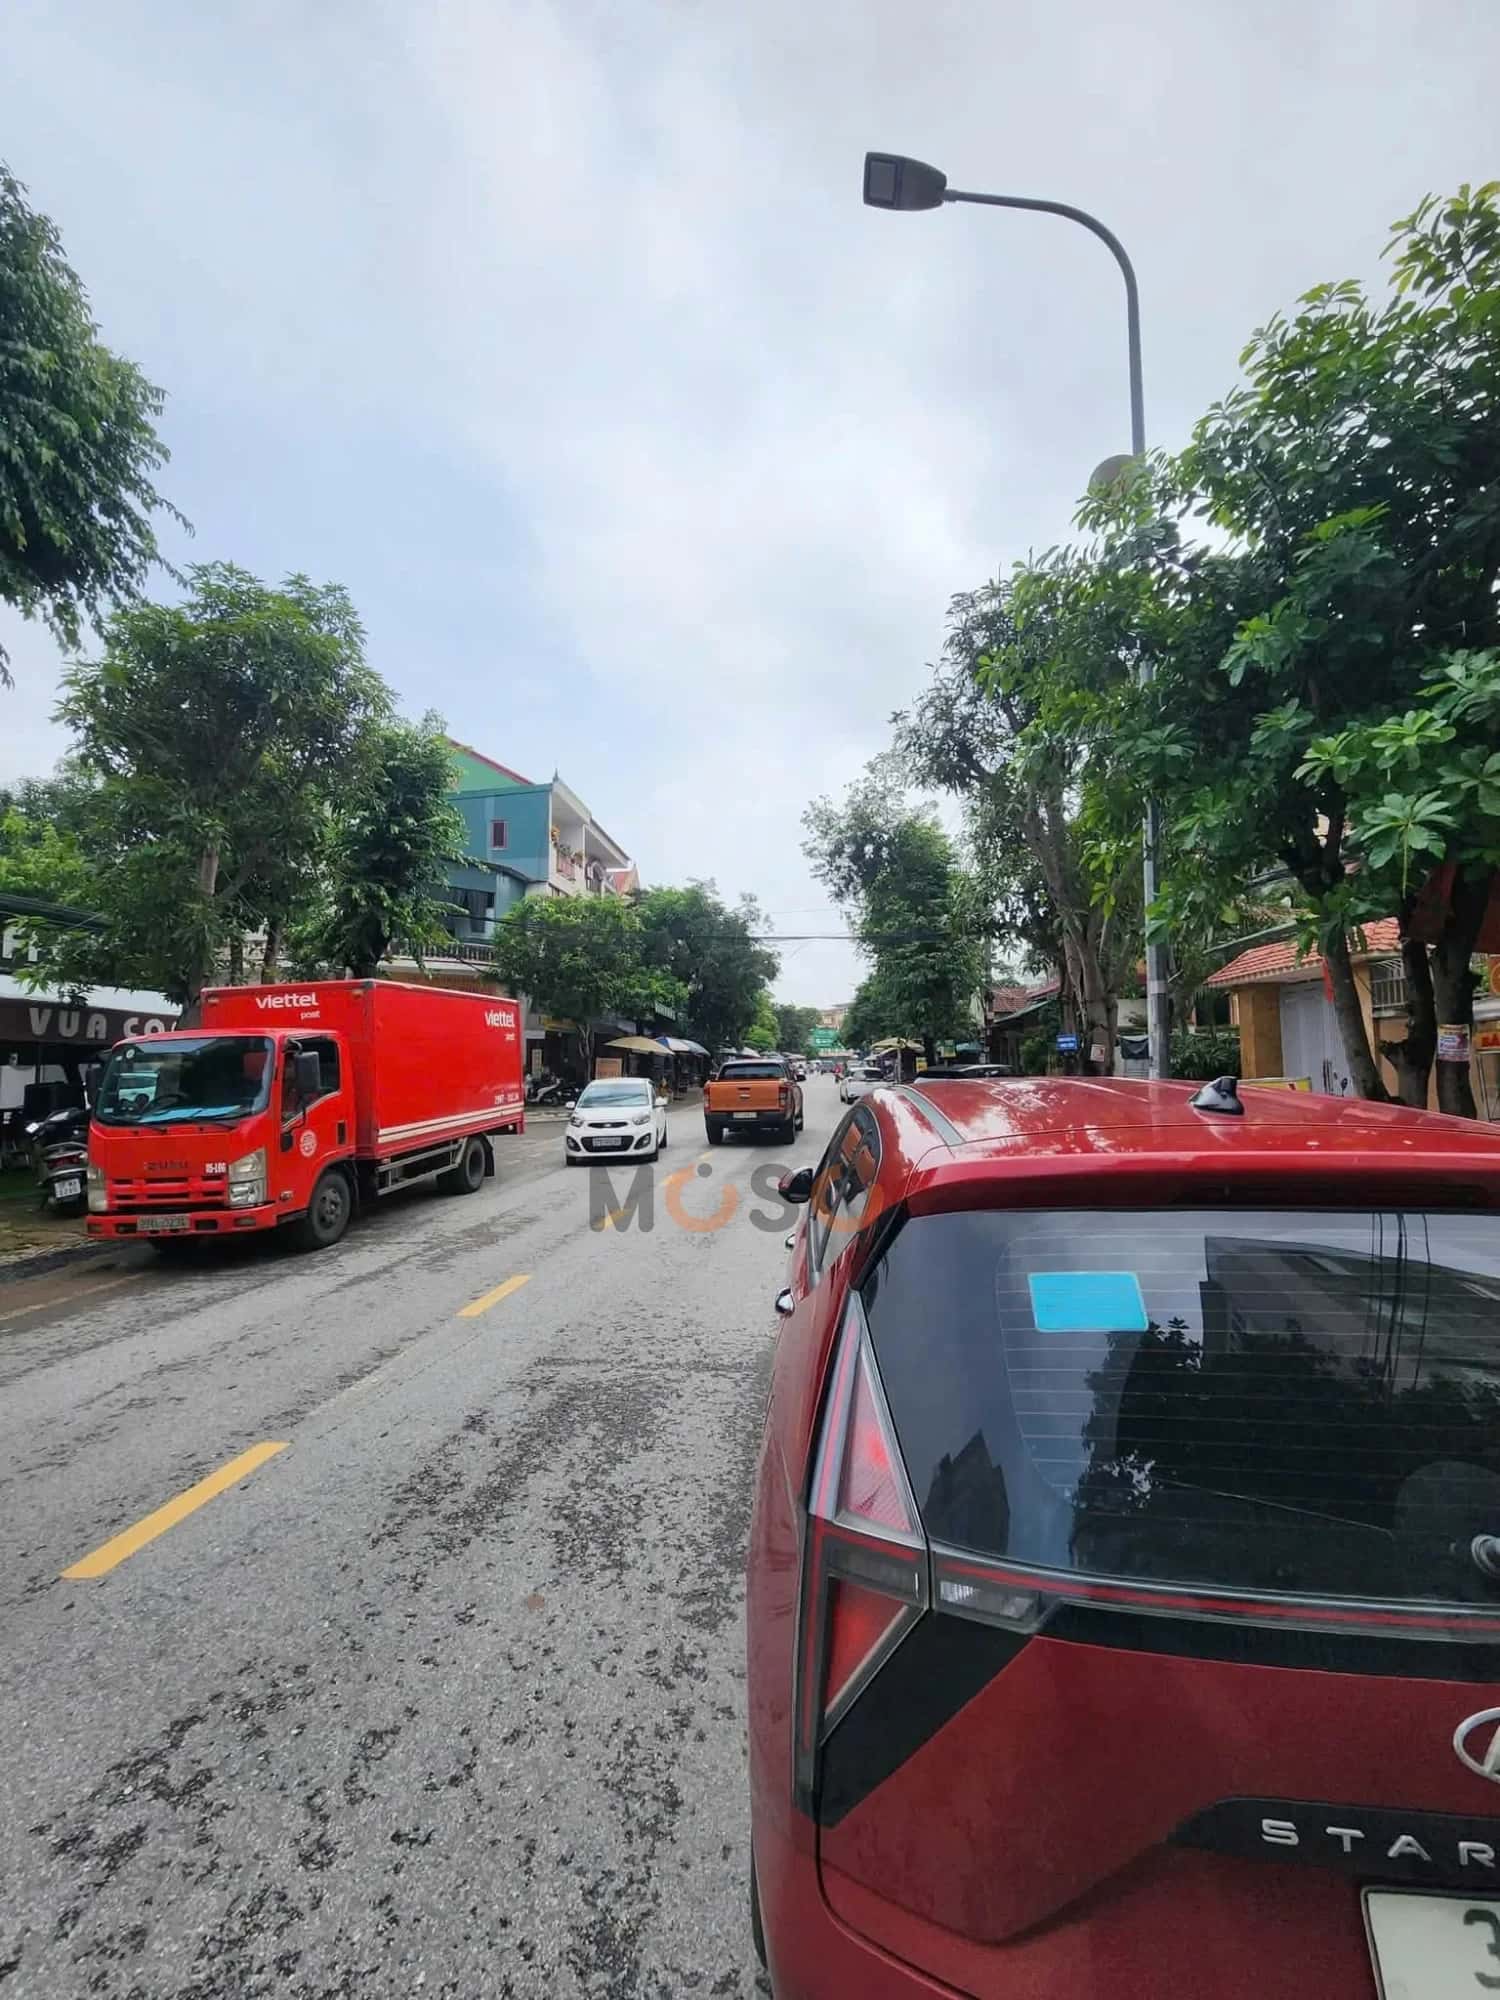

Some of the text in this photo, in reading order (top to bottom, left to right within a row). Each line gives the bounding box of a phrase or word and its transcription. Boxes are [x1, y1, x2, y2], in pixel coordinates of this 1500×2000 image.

[255, 992, 319, 1009] viettel
[29, 1007, 177, 1040] VUA CO
[300, 1010, 320, 1020] post
[484, 1009, 515, 1028] viettel
[1261, 1818, 1496, 1868] STAR
